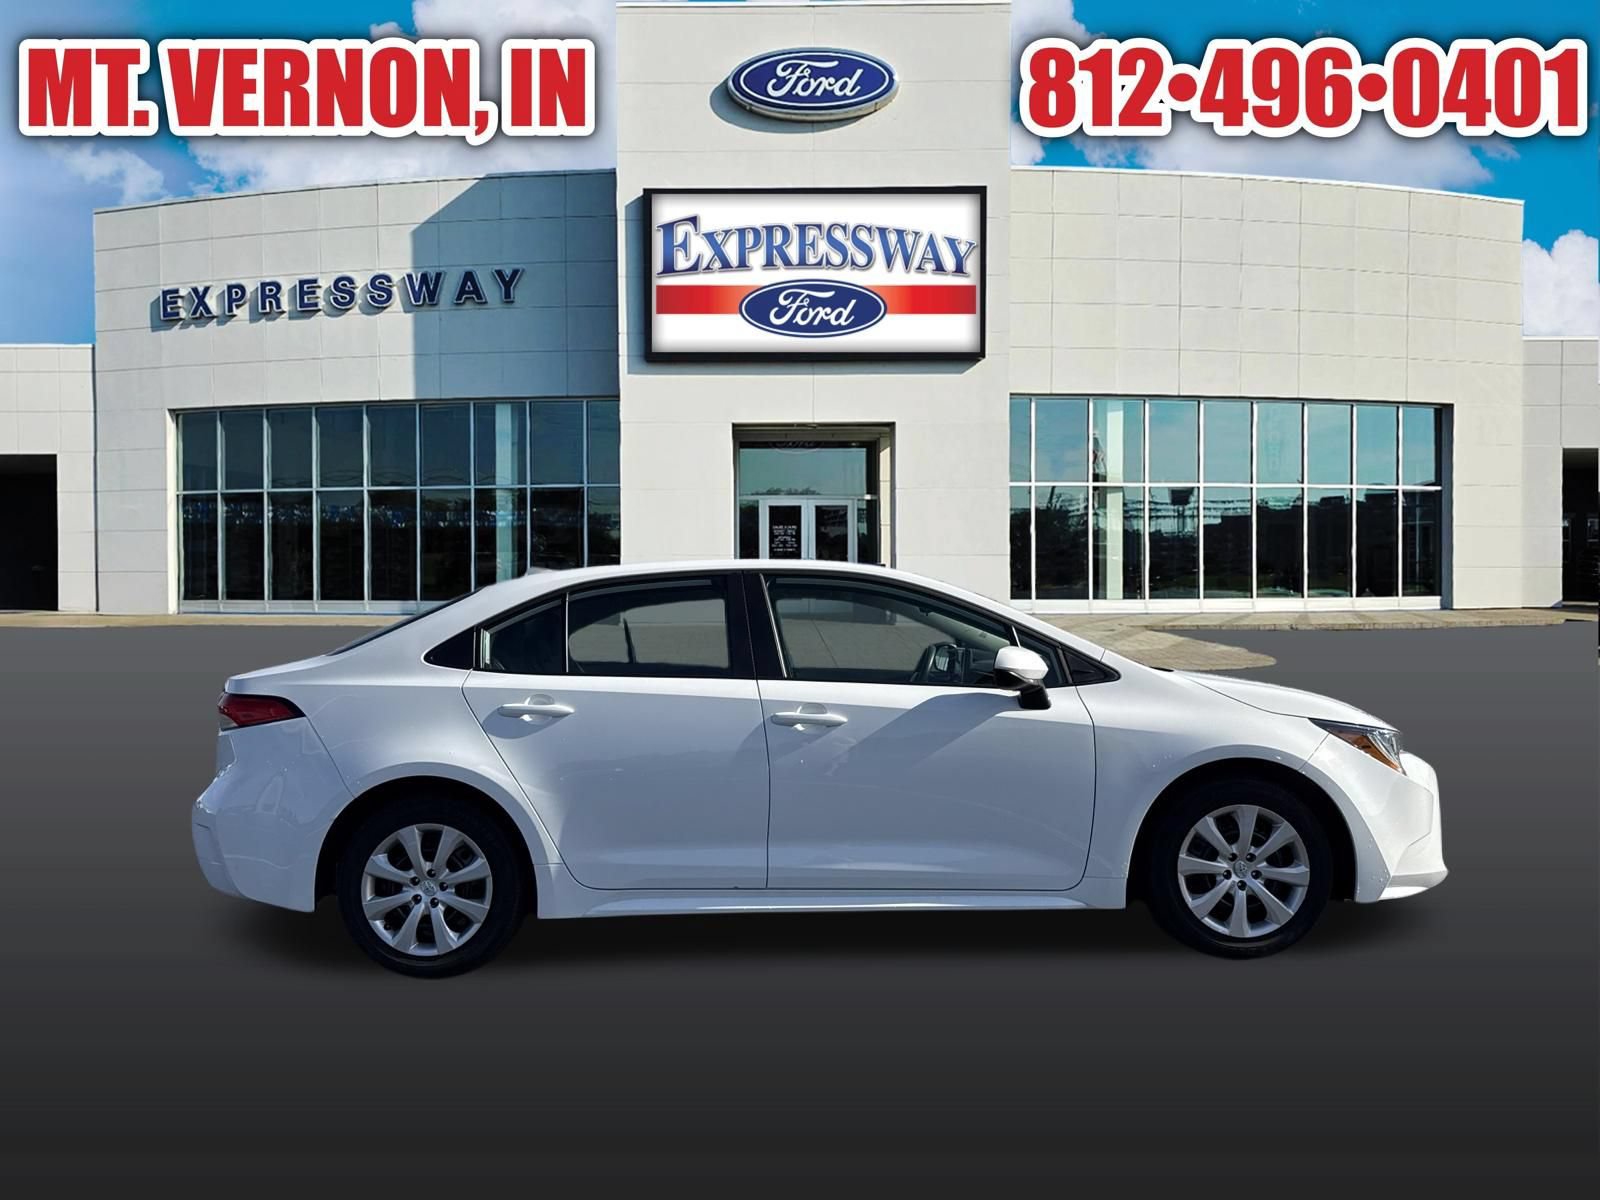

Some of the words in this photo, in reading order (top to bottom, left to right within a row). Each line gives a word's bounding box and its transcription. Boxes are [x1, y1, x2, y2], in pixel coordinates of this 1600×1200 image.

[766, 60, 864, 97] Ford
[656, 214, 978, 277] EXPRESSWAY
[160, 267, 525, 322] EXPRESSWAY
[769, 288, 857, 327] Ford
